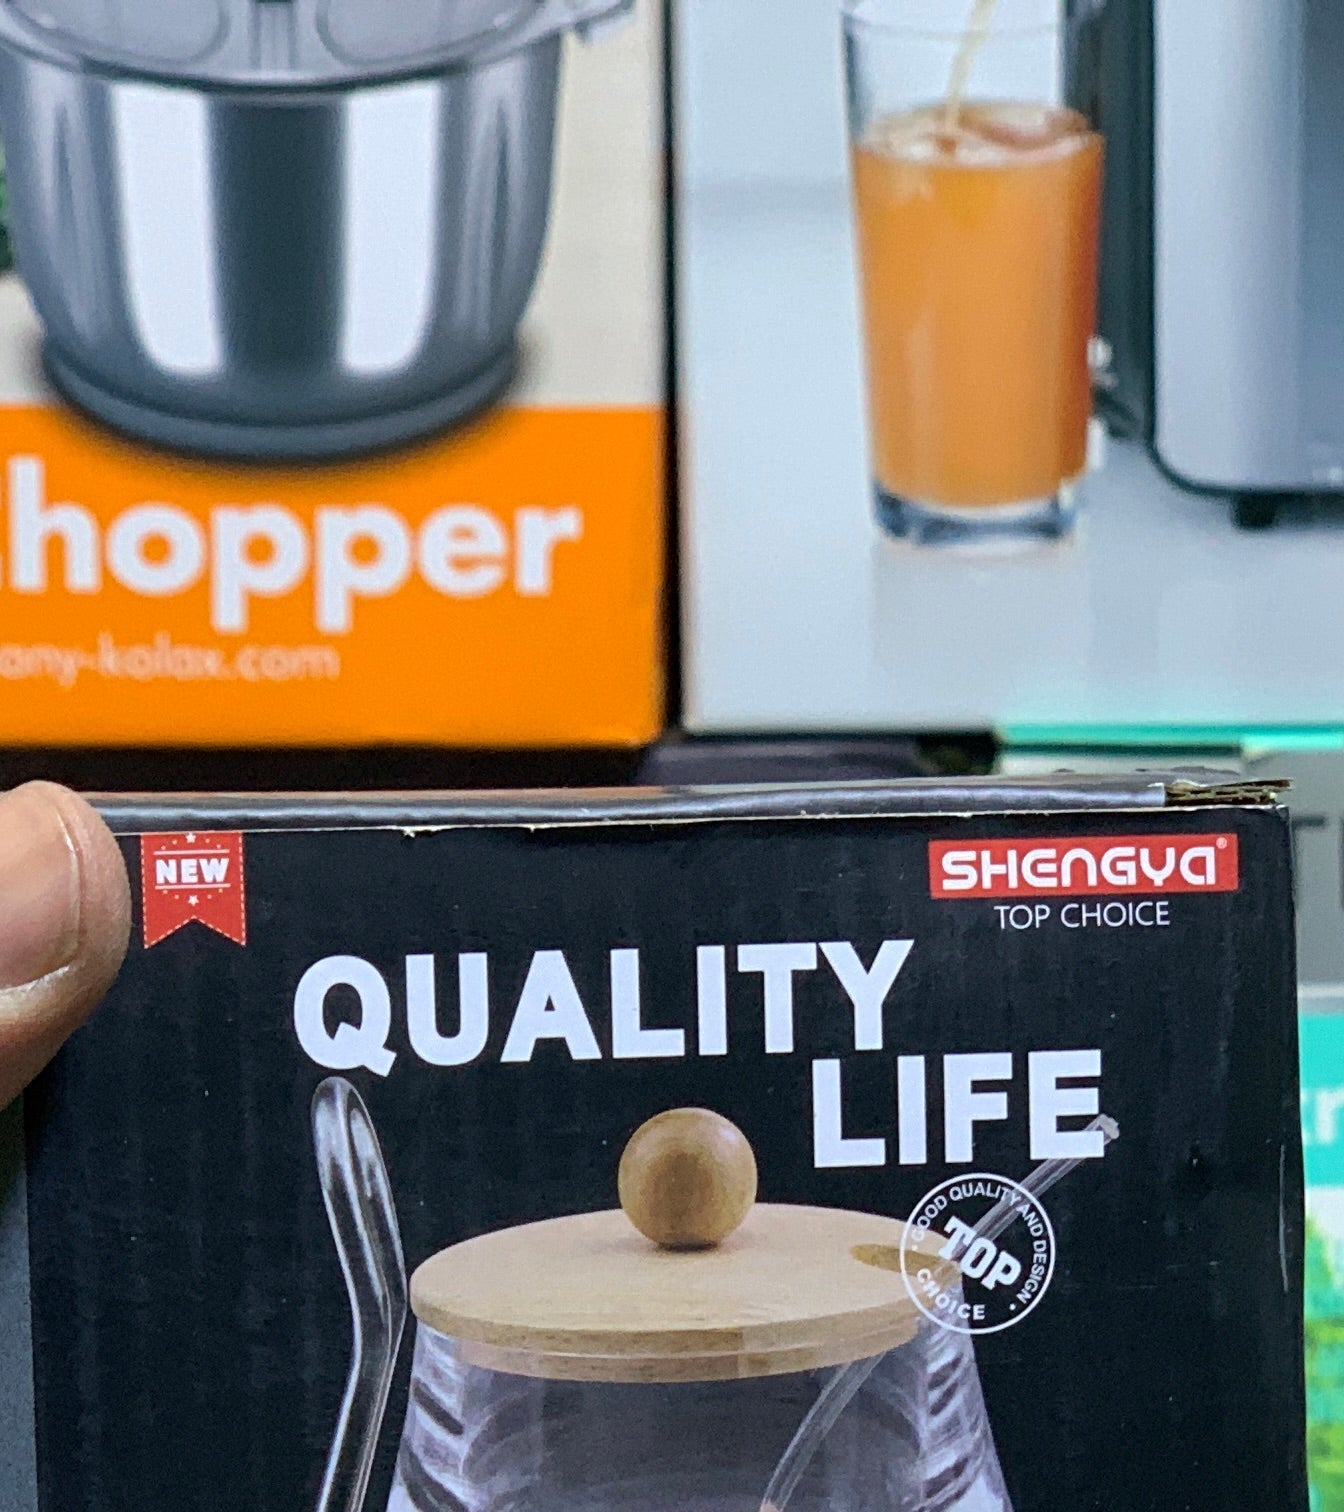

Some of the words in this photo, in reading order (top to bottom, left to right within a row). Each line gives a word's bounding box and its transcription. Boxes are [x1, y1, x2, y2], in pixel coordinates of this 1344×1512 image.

[155, 857, 230, 885] NEW
[994, 904, 1050, 930] TOP
[1060, 901, 1170, 929] CHOICE
[293, 938, 914, 1078] QUALITY
[811, 1049, 1105, 1169] LIFE
[911, 1194, 947, 1241] GOOD
[949, 1181, 1021, 1206] QUALITY
[1015, 1203, 1043, 1237] AND
[938, 1215, 1022, 1290] TOP
[1016, 1239, 1047, 1304] DESIGN
[916, 1268, 985, 1320] CHOICE
